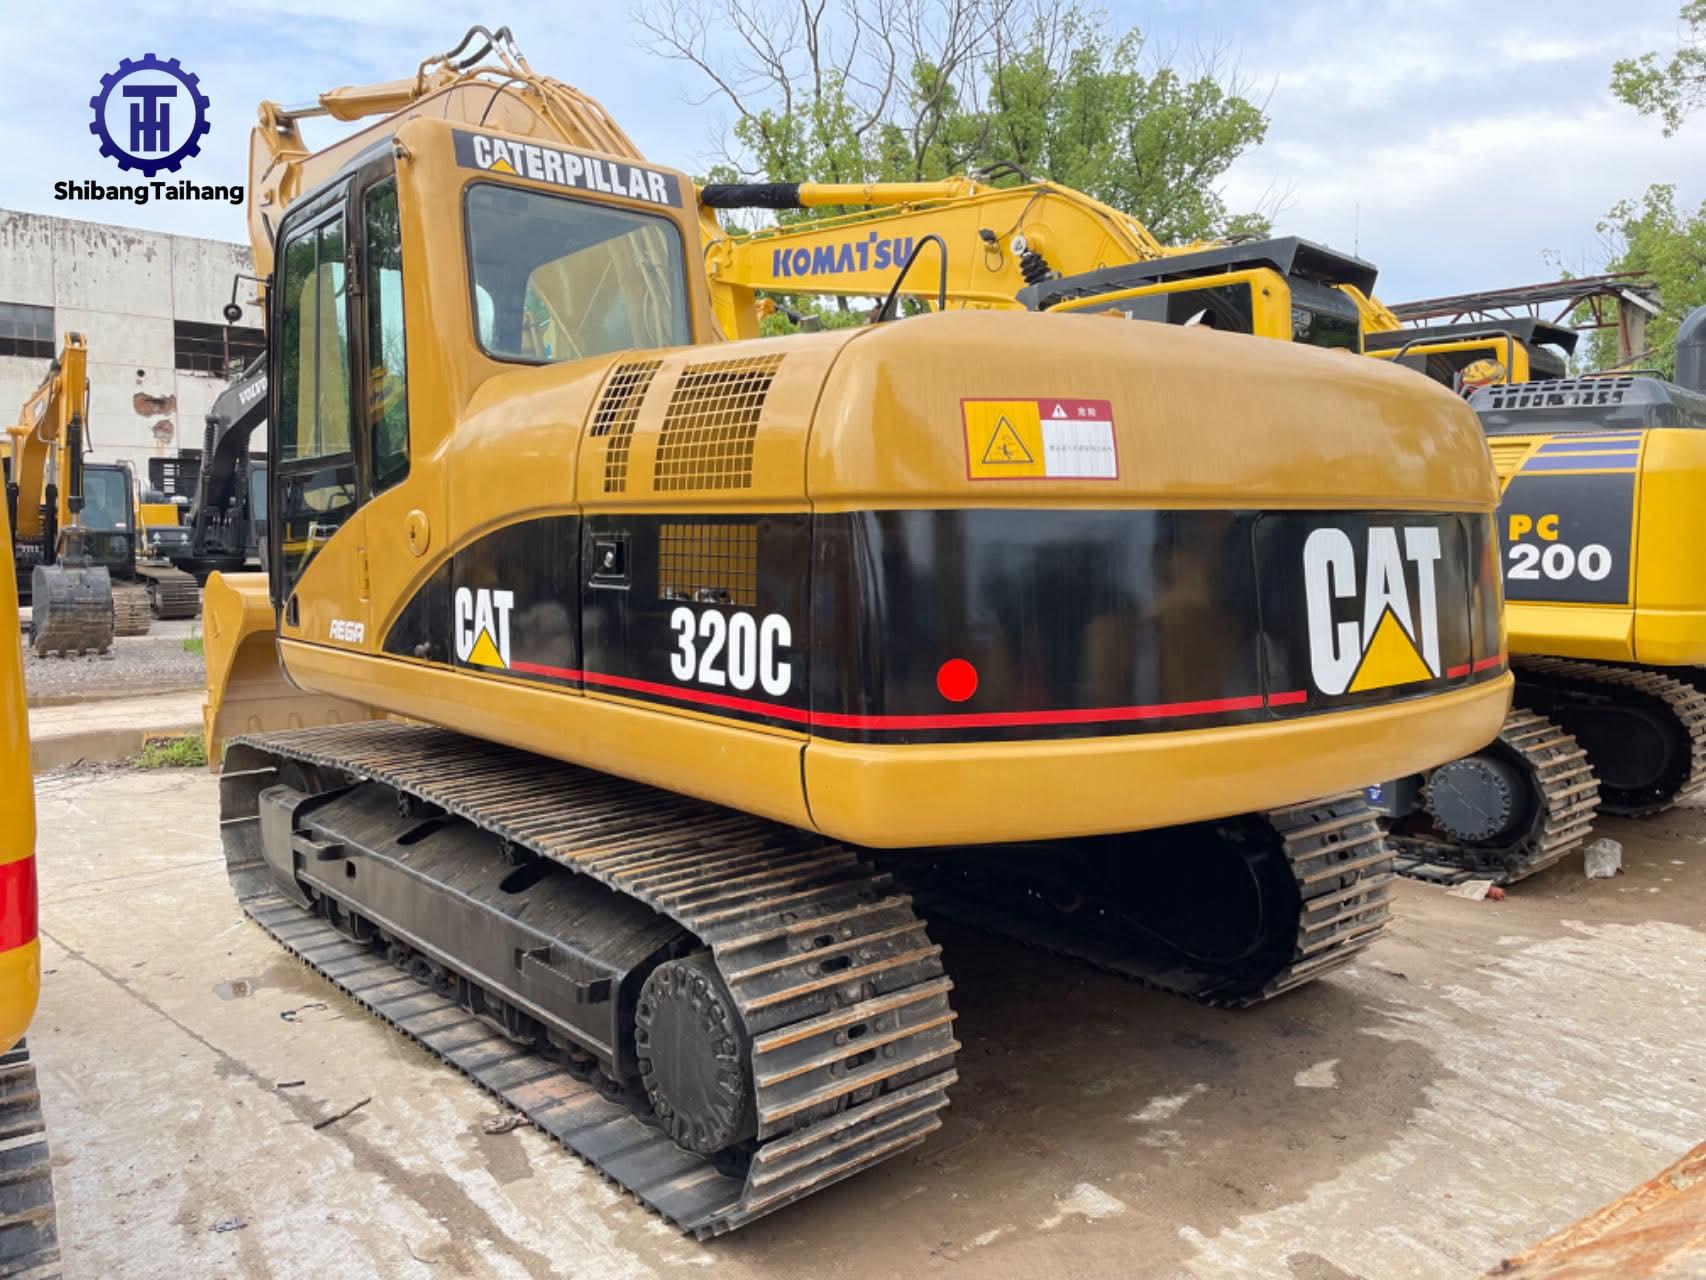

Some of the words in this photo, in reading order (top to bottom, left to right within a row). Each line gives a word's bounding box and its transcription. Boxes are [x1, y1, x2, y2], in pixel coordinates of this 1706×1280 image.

[472, 134, 669, 204] CATERPILLAR
[773, 232, 913, 278] KOMATSU
[1506, 543, 1613, 581] 200
[1508, 513, 1560, 542] PC
[454, 586, 514, 670] CAT
[1303, 526, 1442, 696] CAT
[670, 606, 792, 697] 320C
